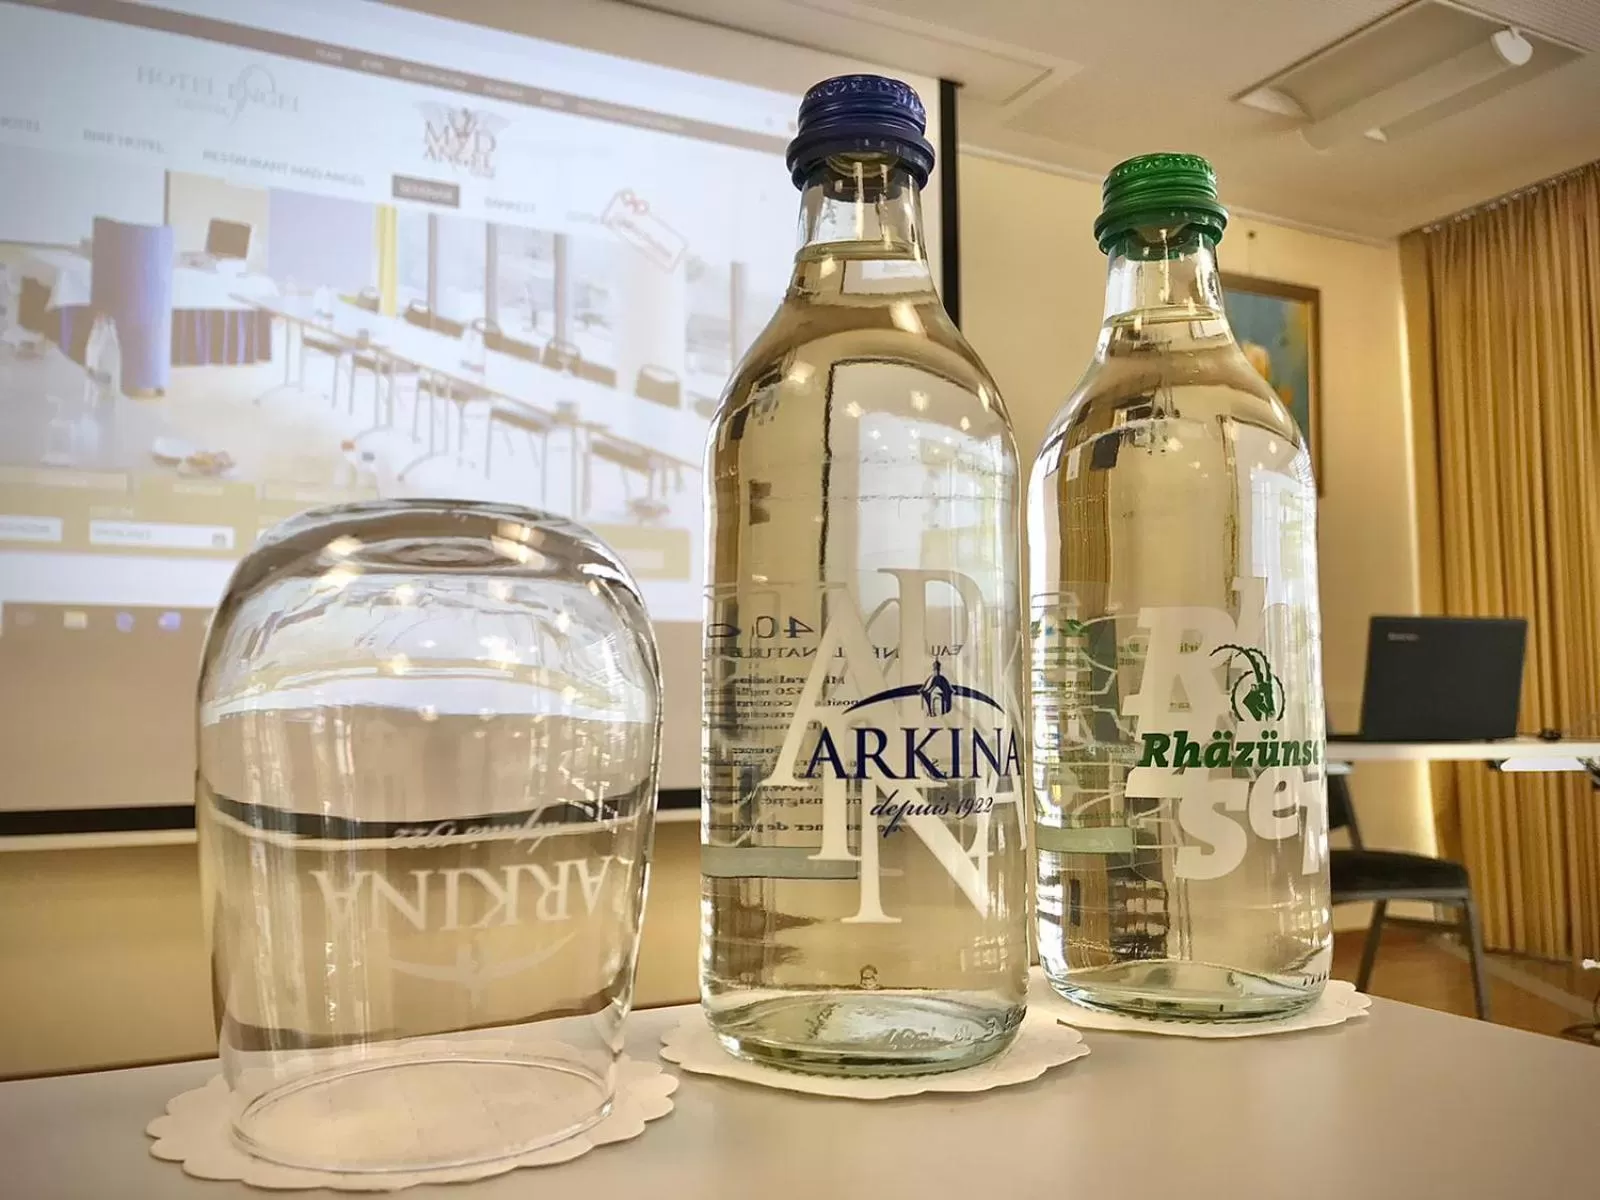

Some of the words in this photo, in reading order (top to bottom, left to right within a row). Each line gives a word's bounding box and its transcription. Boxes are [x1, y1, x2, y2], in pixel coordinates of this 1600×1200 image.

[805, 727, 1022, 780] ARKINA
[1138, 730, 1324, 769] Rhäzüns
[870, 789, 949, 839] depuis
[956, 796, 994, 820] 1922
[308, 856, 615, 932] ARKINA
